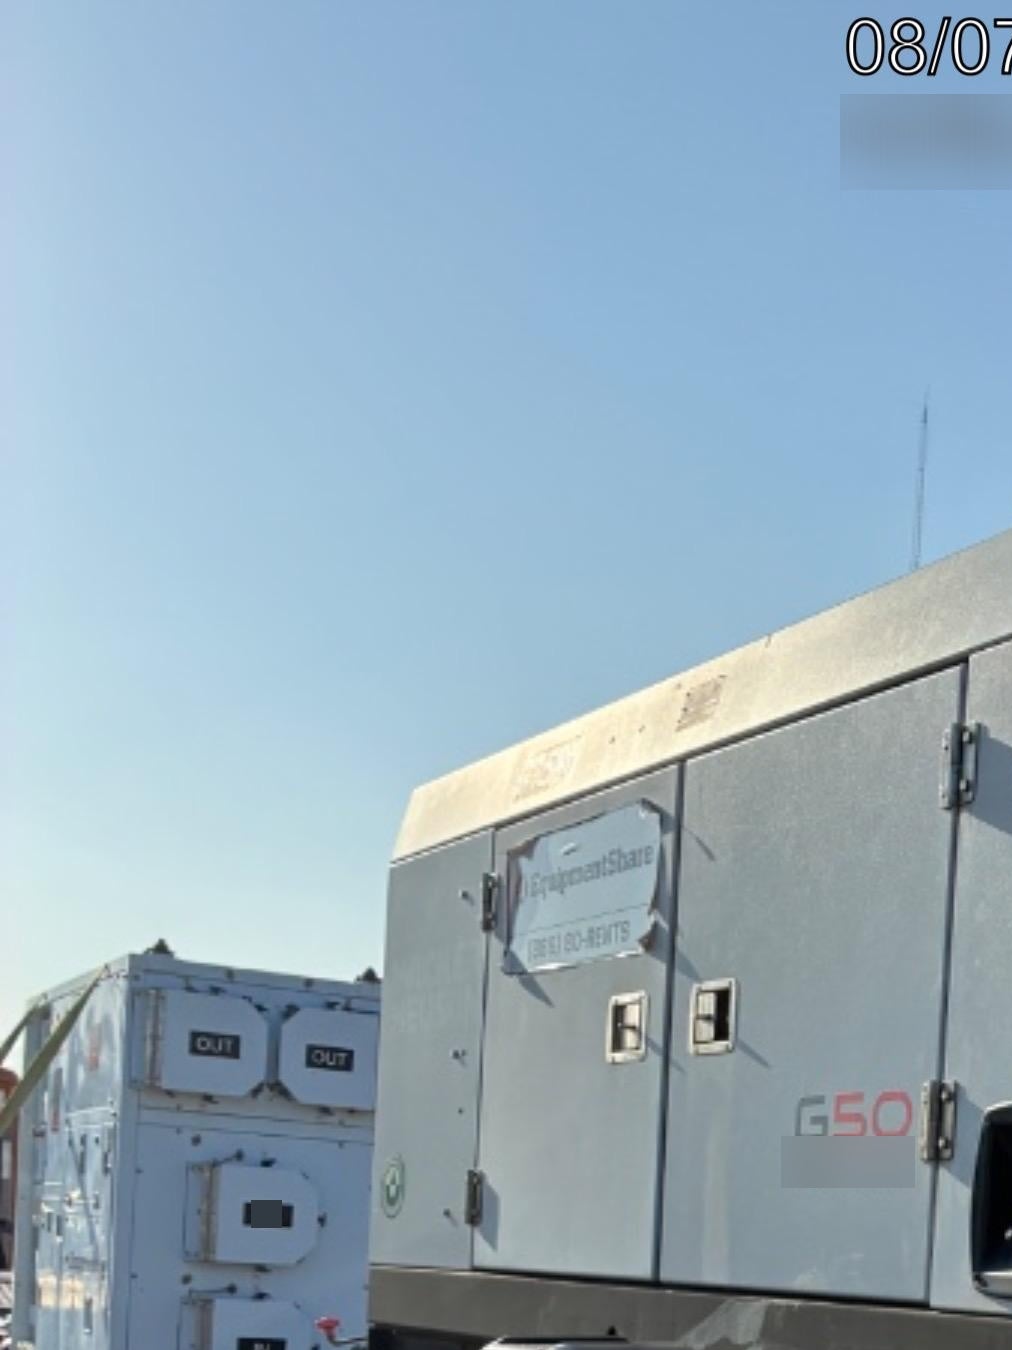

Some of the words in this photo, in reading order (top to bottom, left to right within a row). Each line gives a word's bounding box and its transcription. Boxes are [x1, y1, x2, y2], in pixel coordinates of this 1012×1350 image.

[196, 1036, 234, 1054] OUT
[311, 1049, 349, 1066] OUT
[794, 1090, 914, 1137] G50
